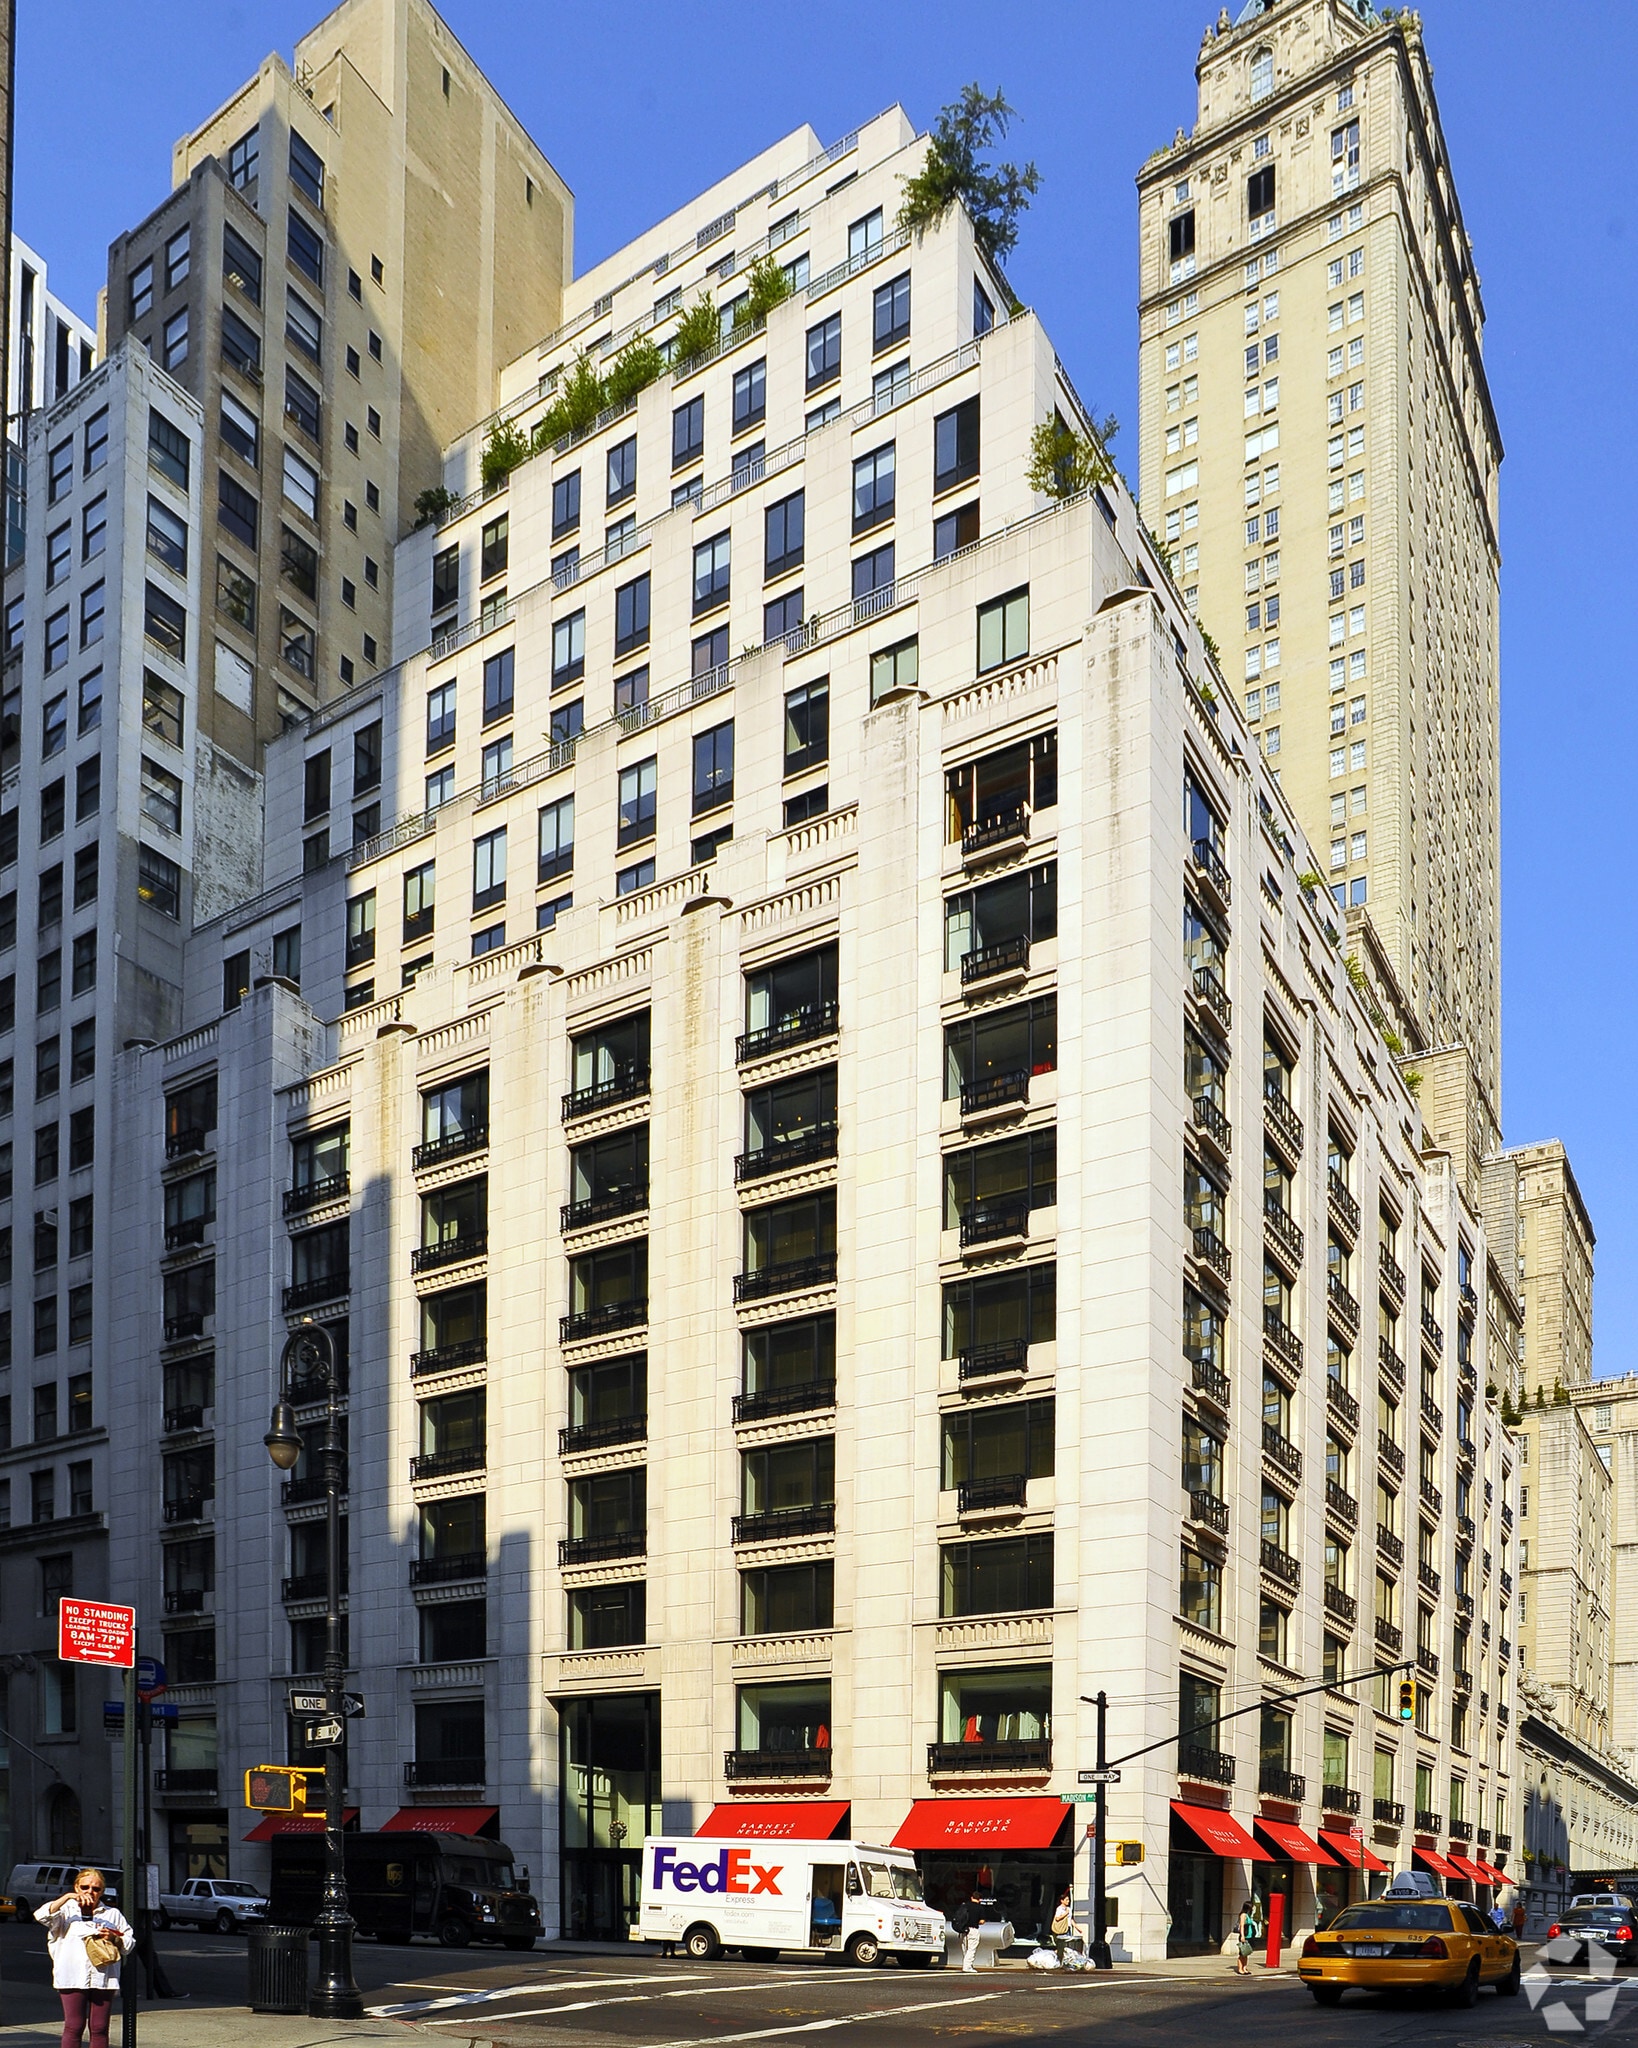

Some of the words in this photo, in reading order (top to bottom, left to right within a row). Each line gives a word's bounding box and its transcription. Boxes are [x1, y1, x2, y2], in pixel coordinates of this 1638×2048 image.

[66, 1605, 80, 1615] NO
[83, 1608, 129, 1622] STANDING
[68, 1616, 96, 1626] EXCEPT
[99, 1620, 126, 1630] TRUCKS
[70, 1630, 125, 1645] 8AM-7PM
[301, 1698, 322, 1709] ONE
[152, 1706, 166, 1715] M1
[152, 1718, 166, 1728] M2
[1061, 1794, 1087, 1802] MADISON
[740, 1822, 796, 1830] BARNEYS
[947, 1818, 1012, 1828] BARNEYS
[652, 1846, 784, 1896] FedEx
[725, 1894, 756, 1905] Express
[724, 1909, 755, 1919] fedex.com
[1407, 1934, 1424, 1942] 635
